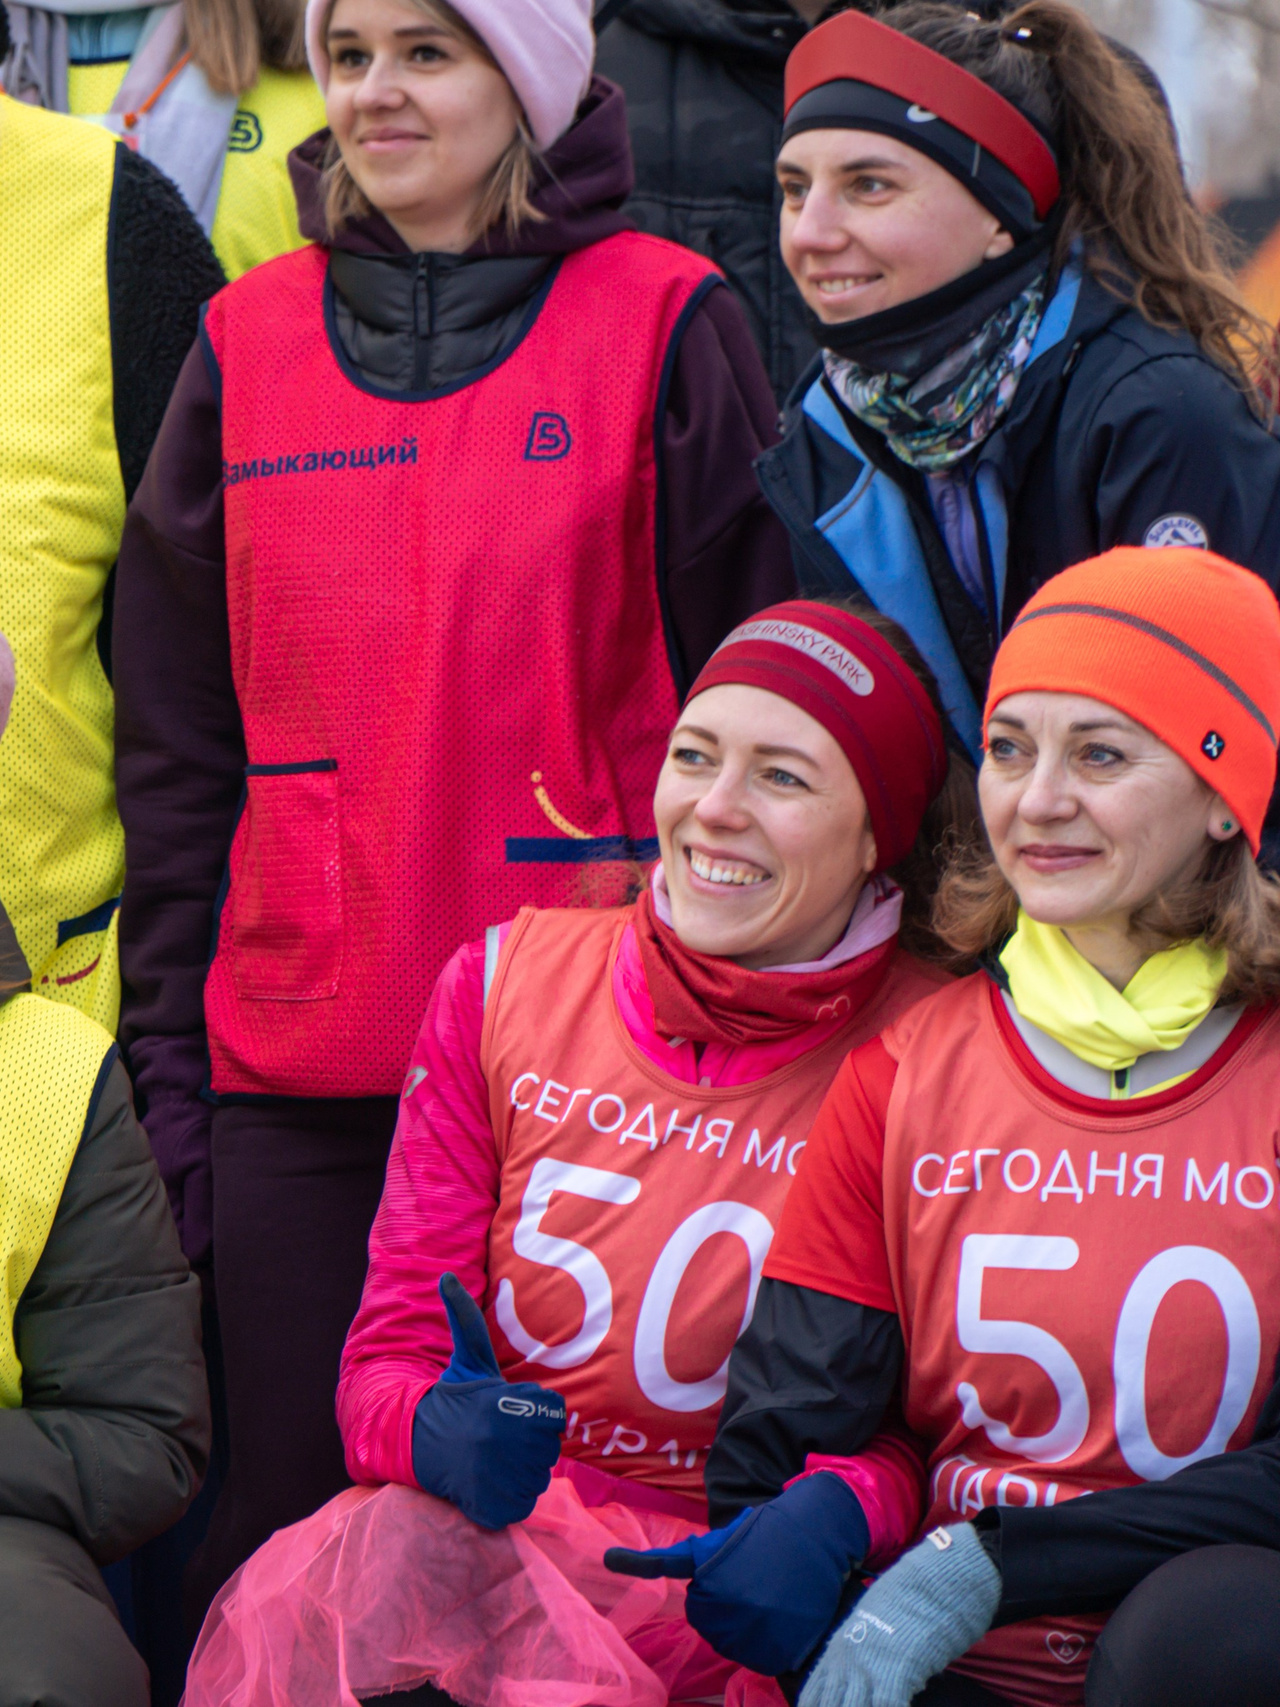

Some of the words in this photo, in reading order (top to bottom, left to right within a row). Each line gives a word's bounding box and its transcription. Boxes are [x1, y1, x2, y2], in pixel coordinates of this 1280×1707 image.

[728, 622, 823, 649] ASHINSKY
[821, 645, 867, 686] PARK
[510, 1072, 734, 1158] СЕГОДНЯ
[913, 1148, 1164, 1204] СЕГОДНЯ
[1184, 1157, 1280, 1209] МО
[495, 1157, 775, 1413] 50
[956, 1233, 1262, 1482] 50
